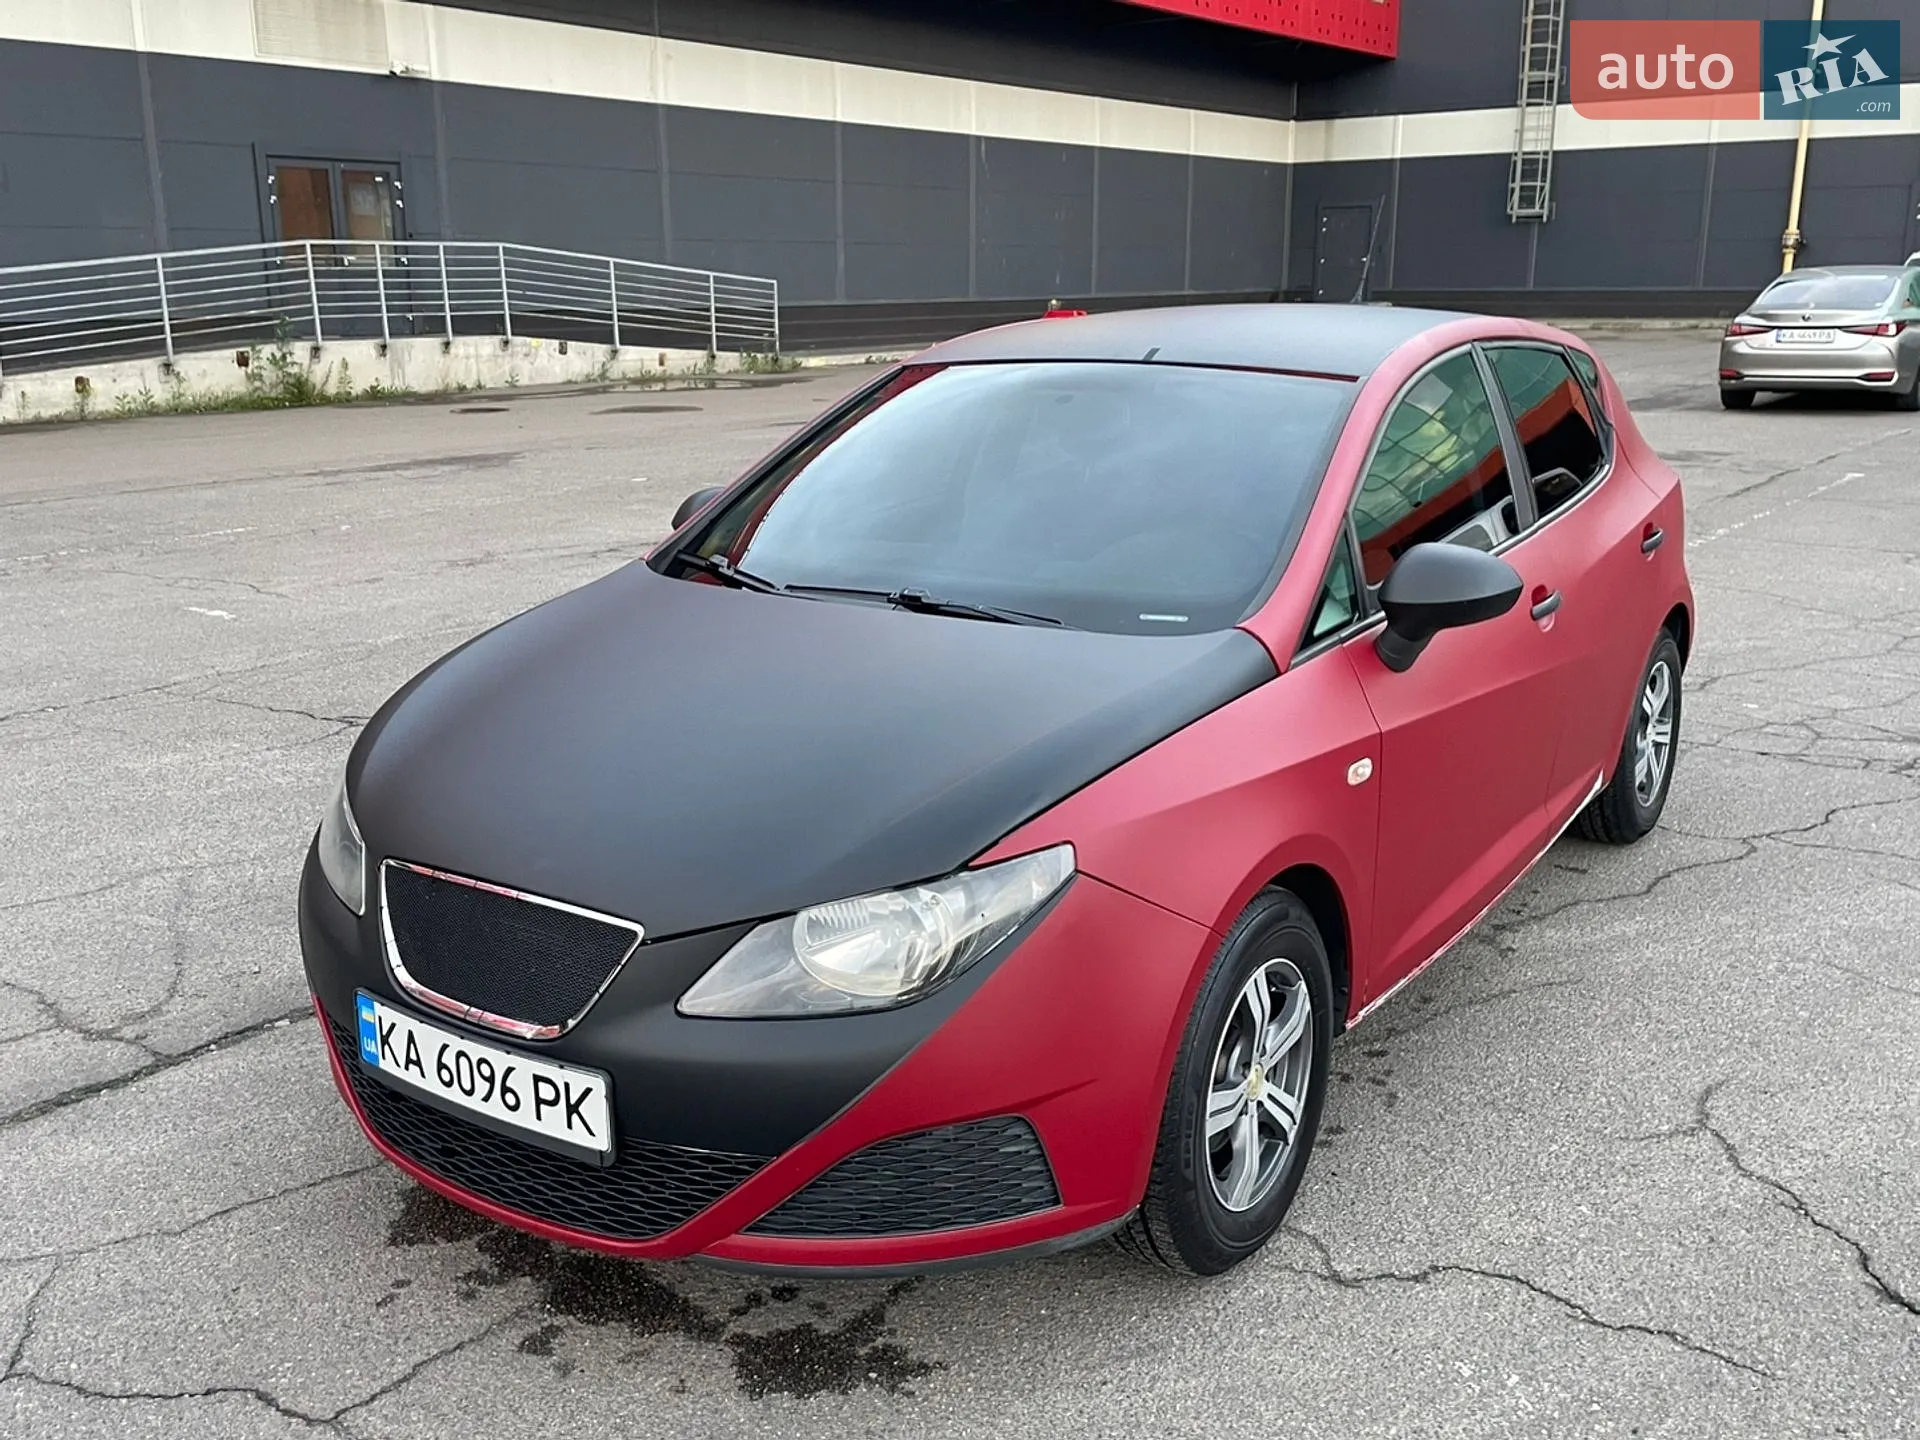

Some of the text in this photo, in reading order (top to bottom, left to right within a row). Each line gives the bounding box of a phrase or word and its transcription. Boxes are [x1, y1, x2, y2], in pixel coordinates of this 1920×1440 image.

[363, 1036, 378, 1055] UA
[378, 1015, 596, 1137] KA 6096 PK
